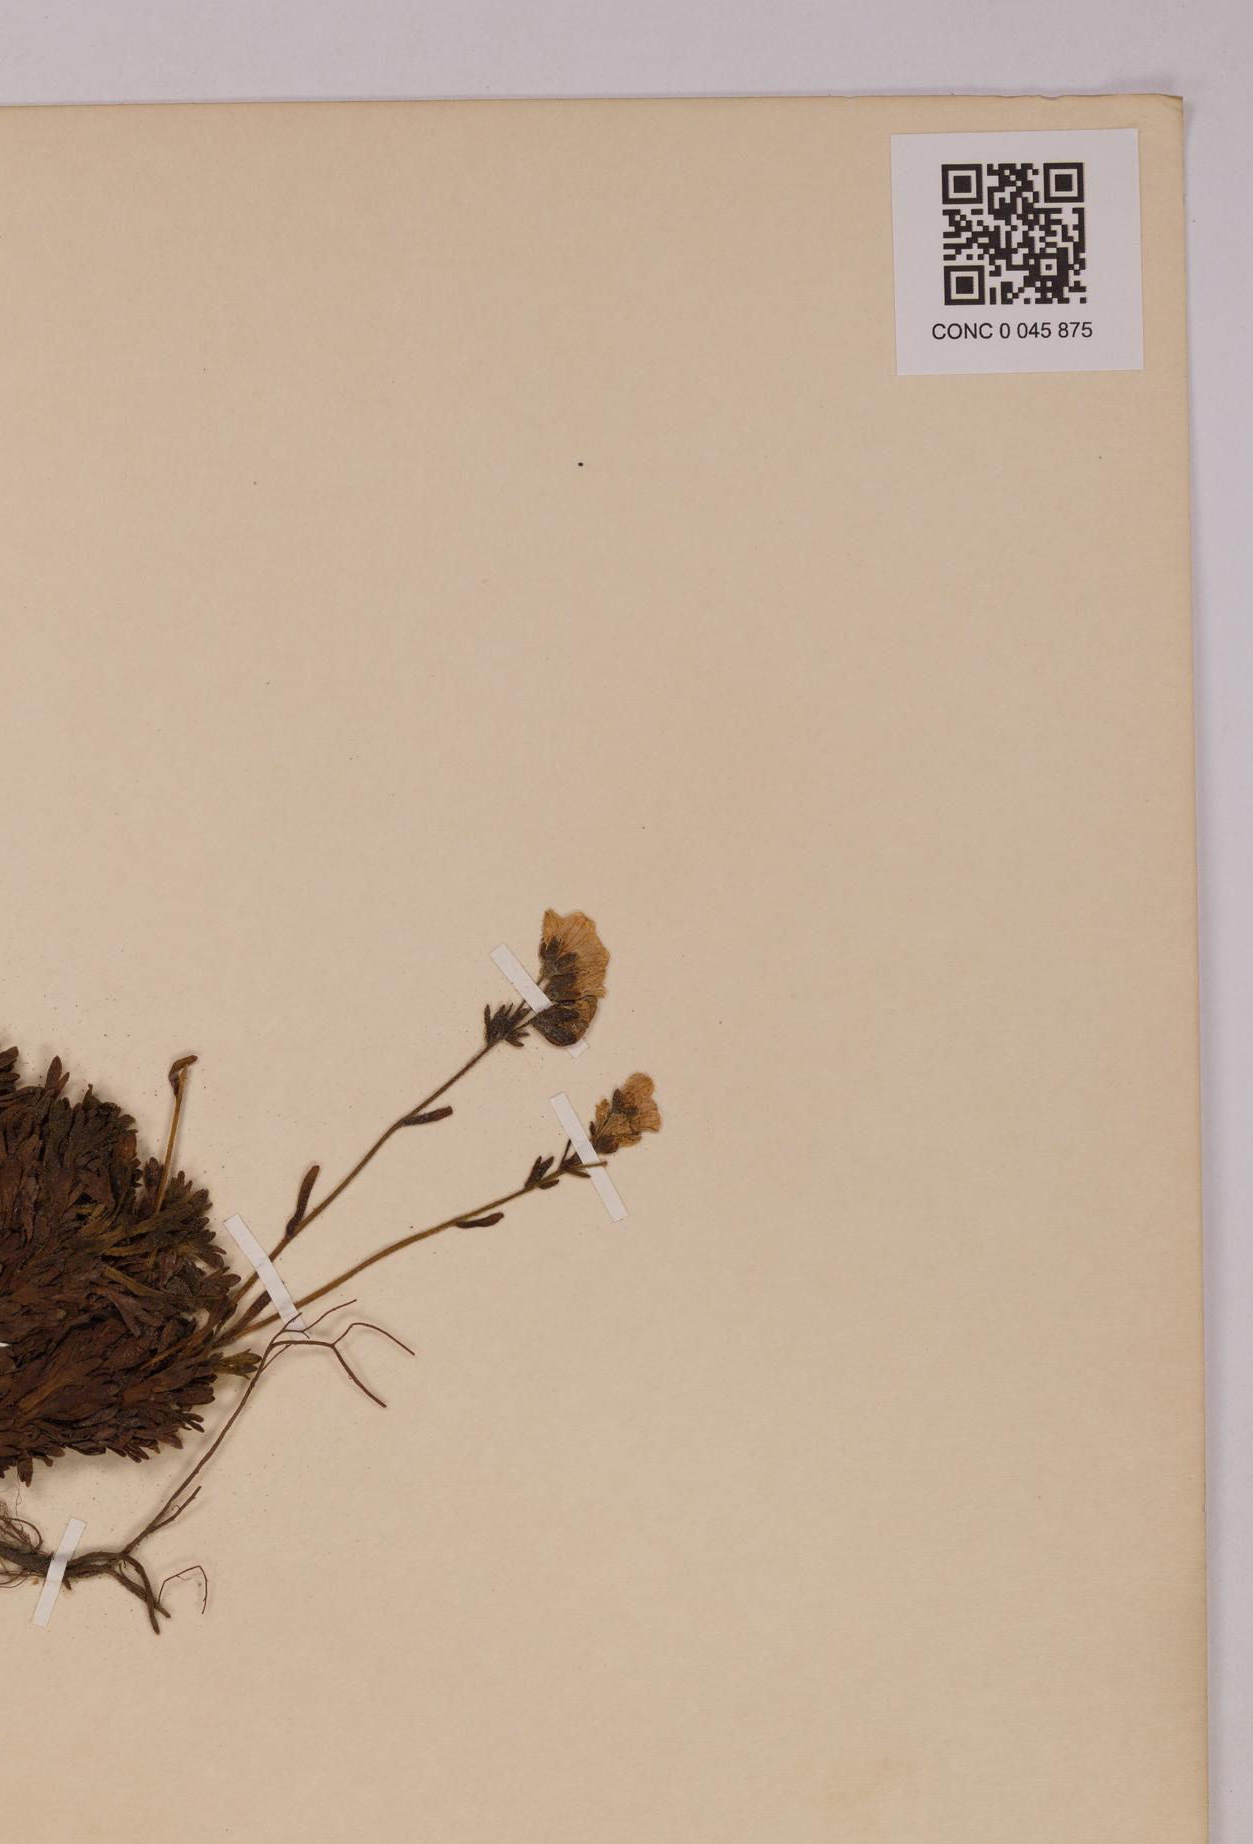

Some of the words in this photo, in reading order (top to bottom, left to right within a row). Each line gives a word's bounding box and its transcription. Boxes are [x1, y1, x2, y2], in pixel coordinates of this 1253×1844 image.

[933, 323, 992, 339] CONC
[1000, 323, 1010, 338] 0
[1017, 323, 1051, 338] 045
[1059, 322, 1092, 338] 875
